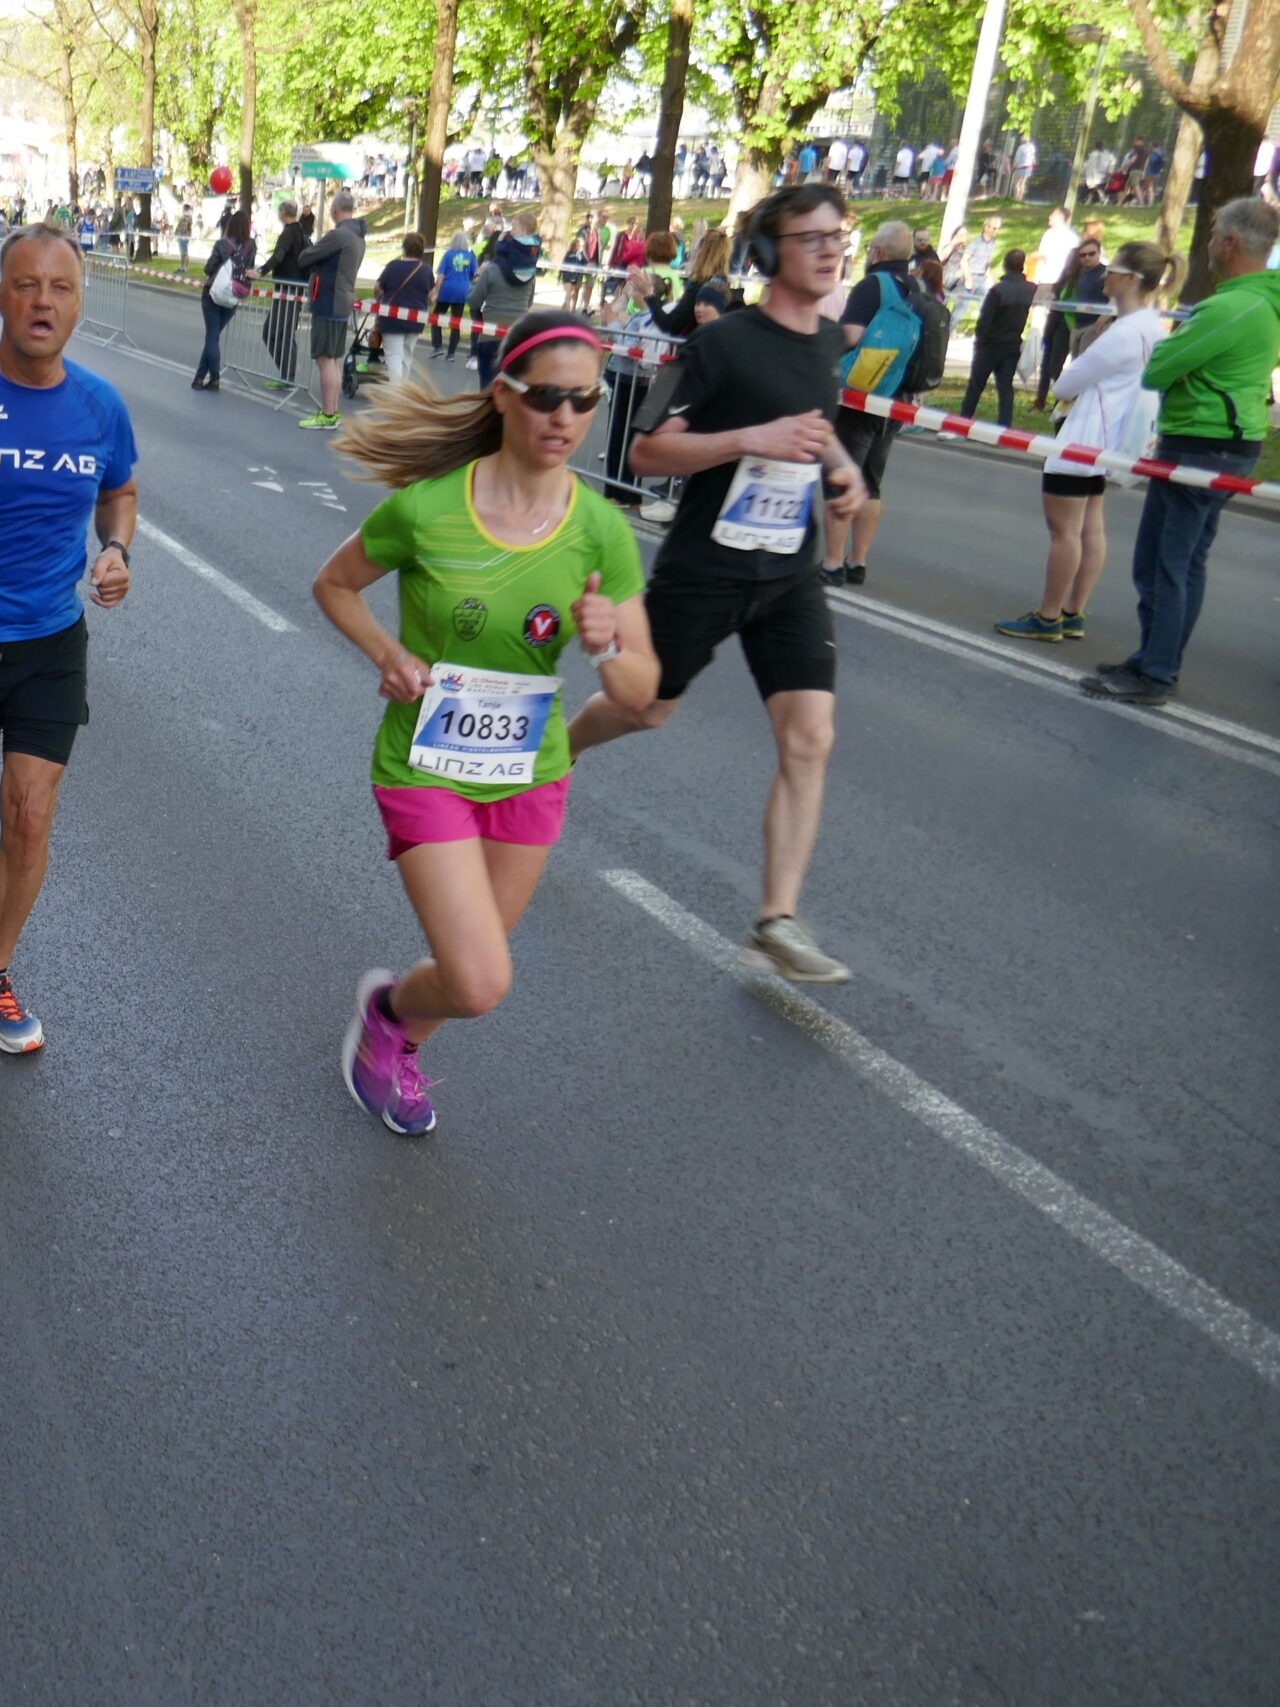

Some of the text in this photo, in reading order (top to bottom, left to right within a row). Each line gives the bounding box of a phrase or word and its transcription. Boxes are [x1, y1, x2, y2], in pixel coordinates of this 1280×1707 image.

[52, 453, 97, 475] AG
[440, 710, 530, 741] 10833
[417, 754, 526, 776] LINZ AG
